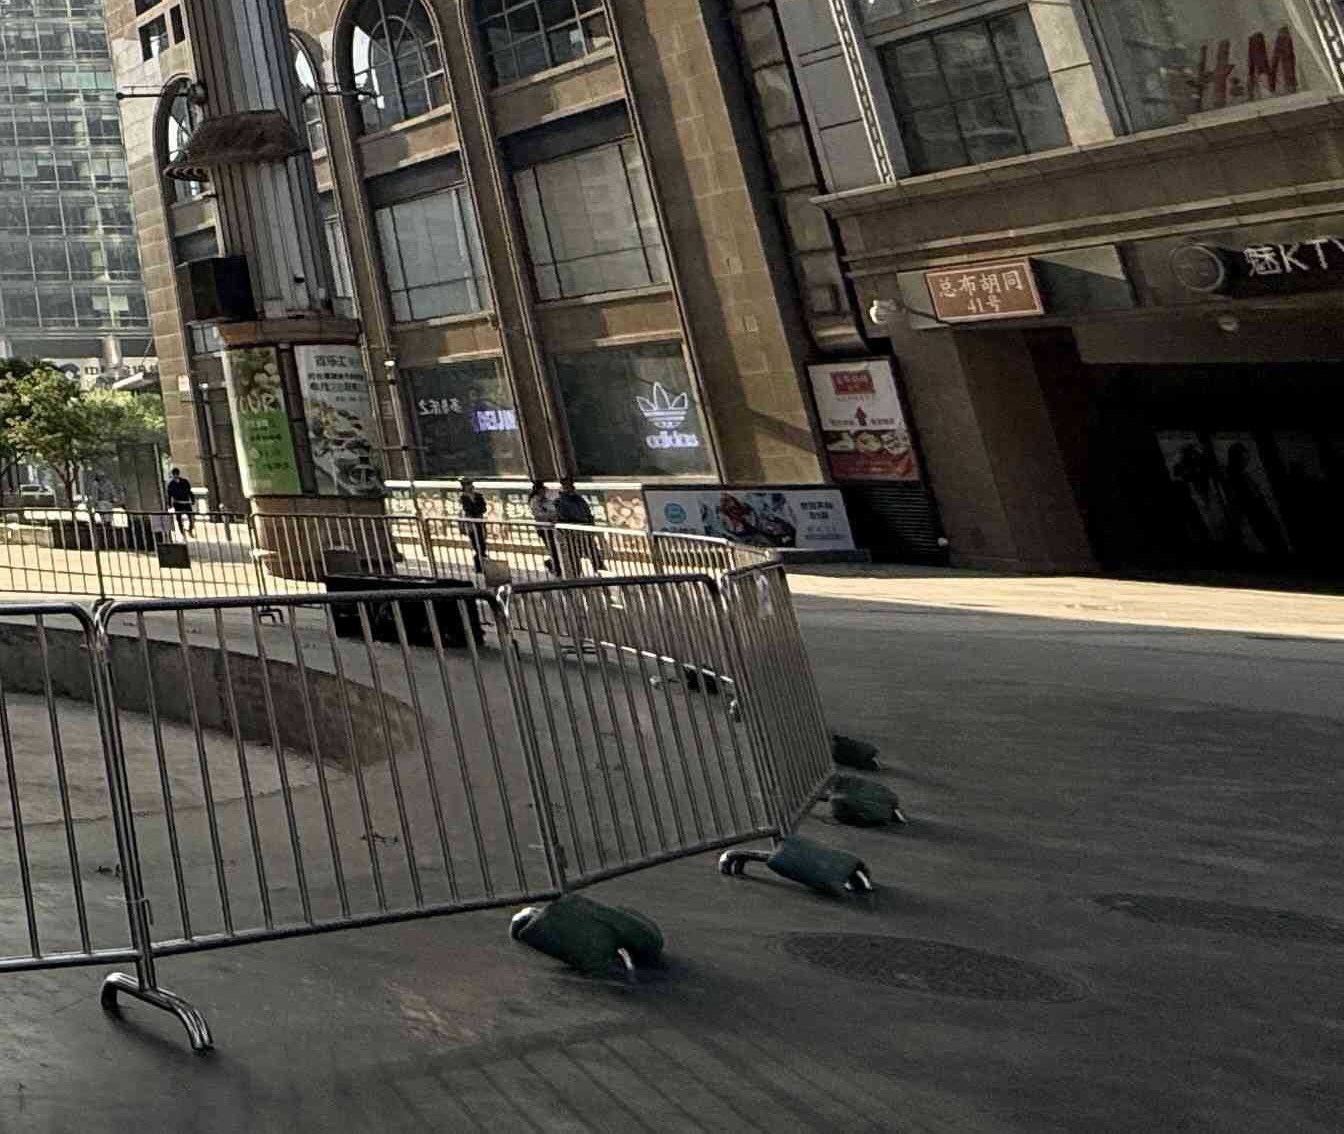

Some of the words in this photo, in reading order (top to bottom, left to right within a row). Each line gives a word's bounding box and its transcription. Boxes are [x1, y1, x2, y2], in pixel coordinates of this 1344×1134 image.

[938, 269, 1024, 298] 总布胡同
[967, 294, 1002, 313] 41号
